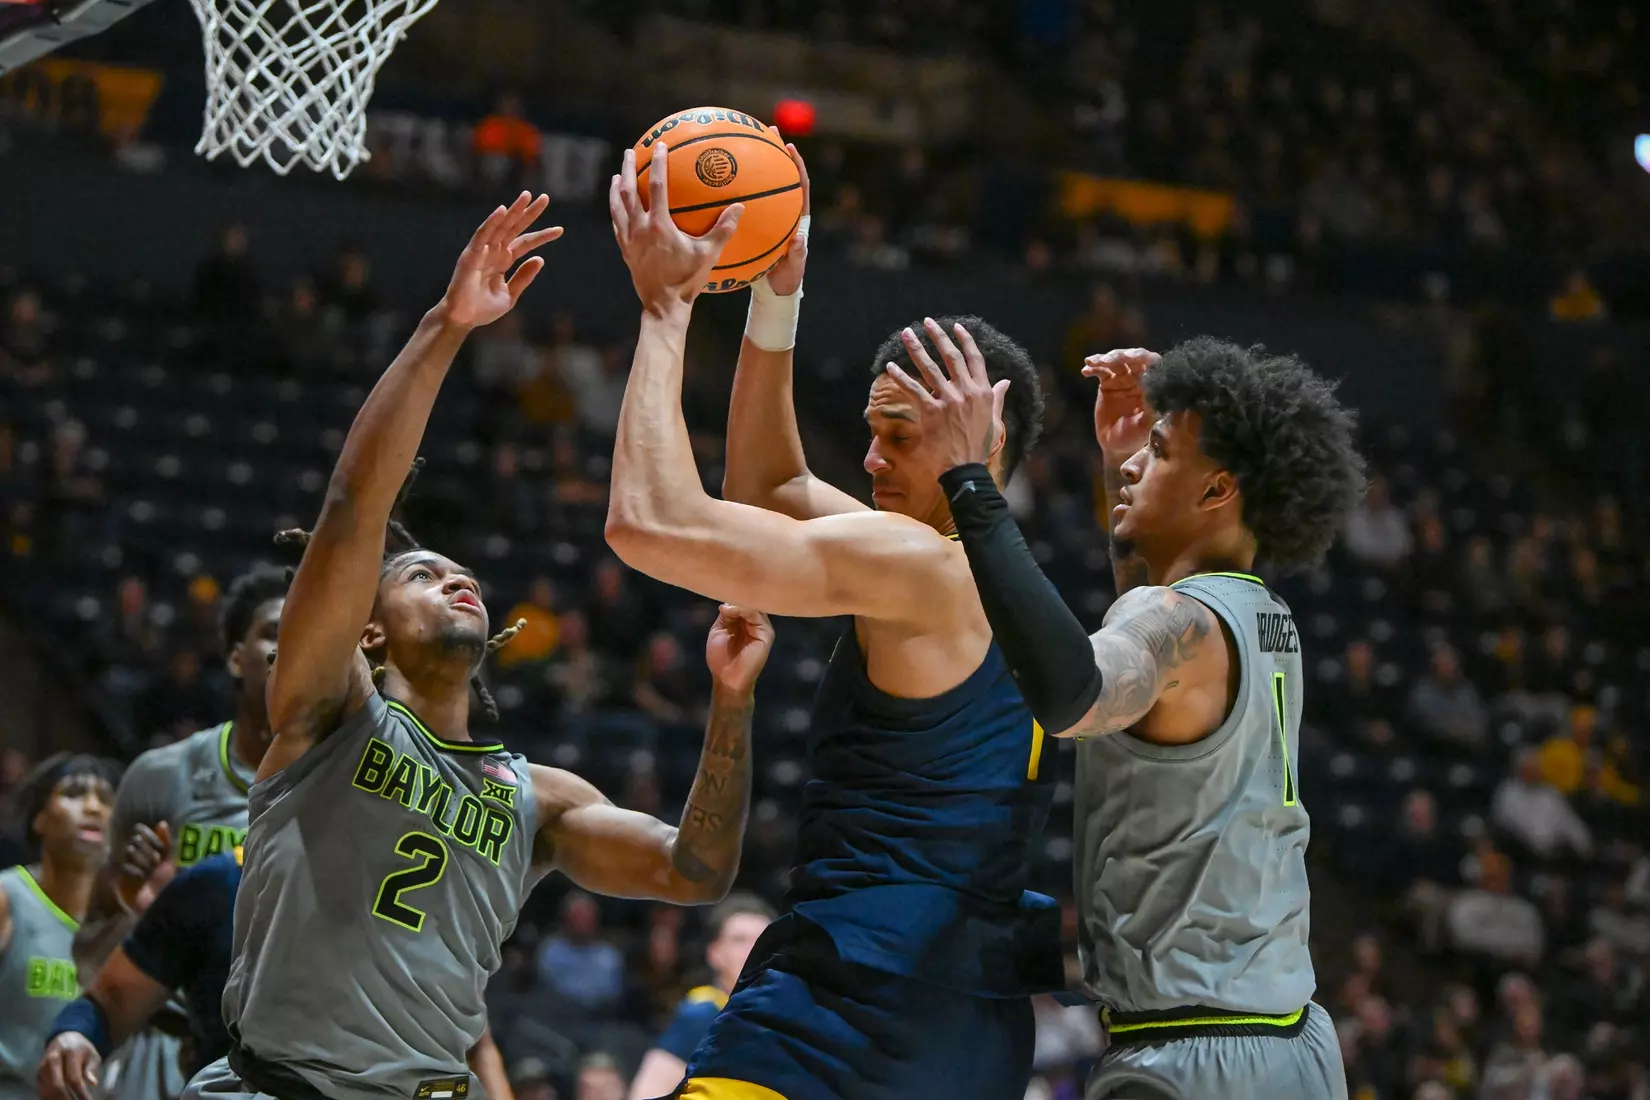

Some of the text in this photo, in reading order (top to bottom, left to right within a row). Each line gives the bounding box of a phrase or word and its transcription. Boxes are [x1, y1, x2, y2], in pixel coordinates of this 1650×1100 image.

[480, 778, 517, 808] XII
[1270, 671, 1298, 807] 1
[352, 737, 513, 866] BAYLOR
[372, 831, 448, 932] 2
